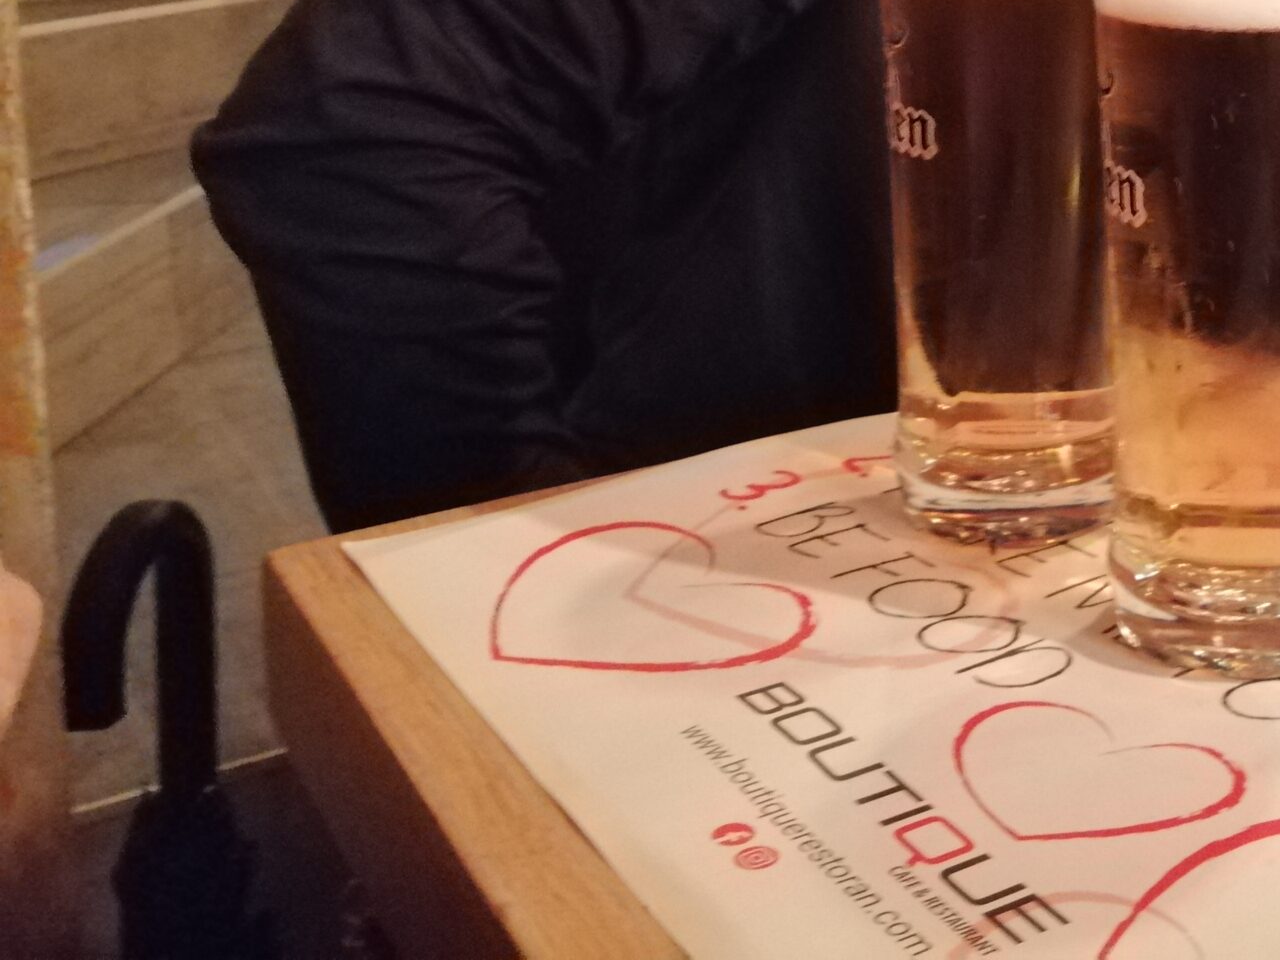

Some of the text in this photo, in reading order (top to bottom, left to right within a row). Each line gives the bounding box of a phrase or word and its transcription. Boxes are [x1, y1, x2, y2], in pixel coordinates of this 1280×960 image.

[755, 501, 891, 558] BE
[829, 551, 1073, 689] FOOD
[679, 724, 933, 957] www.boutiquerestoran.com
[736, 681, 1070, 945] BOUTIQUE
[924, 895, 1000, 956] RESTAURANT
